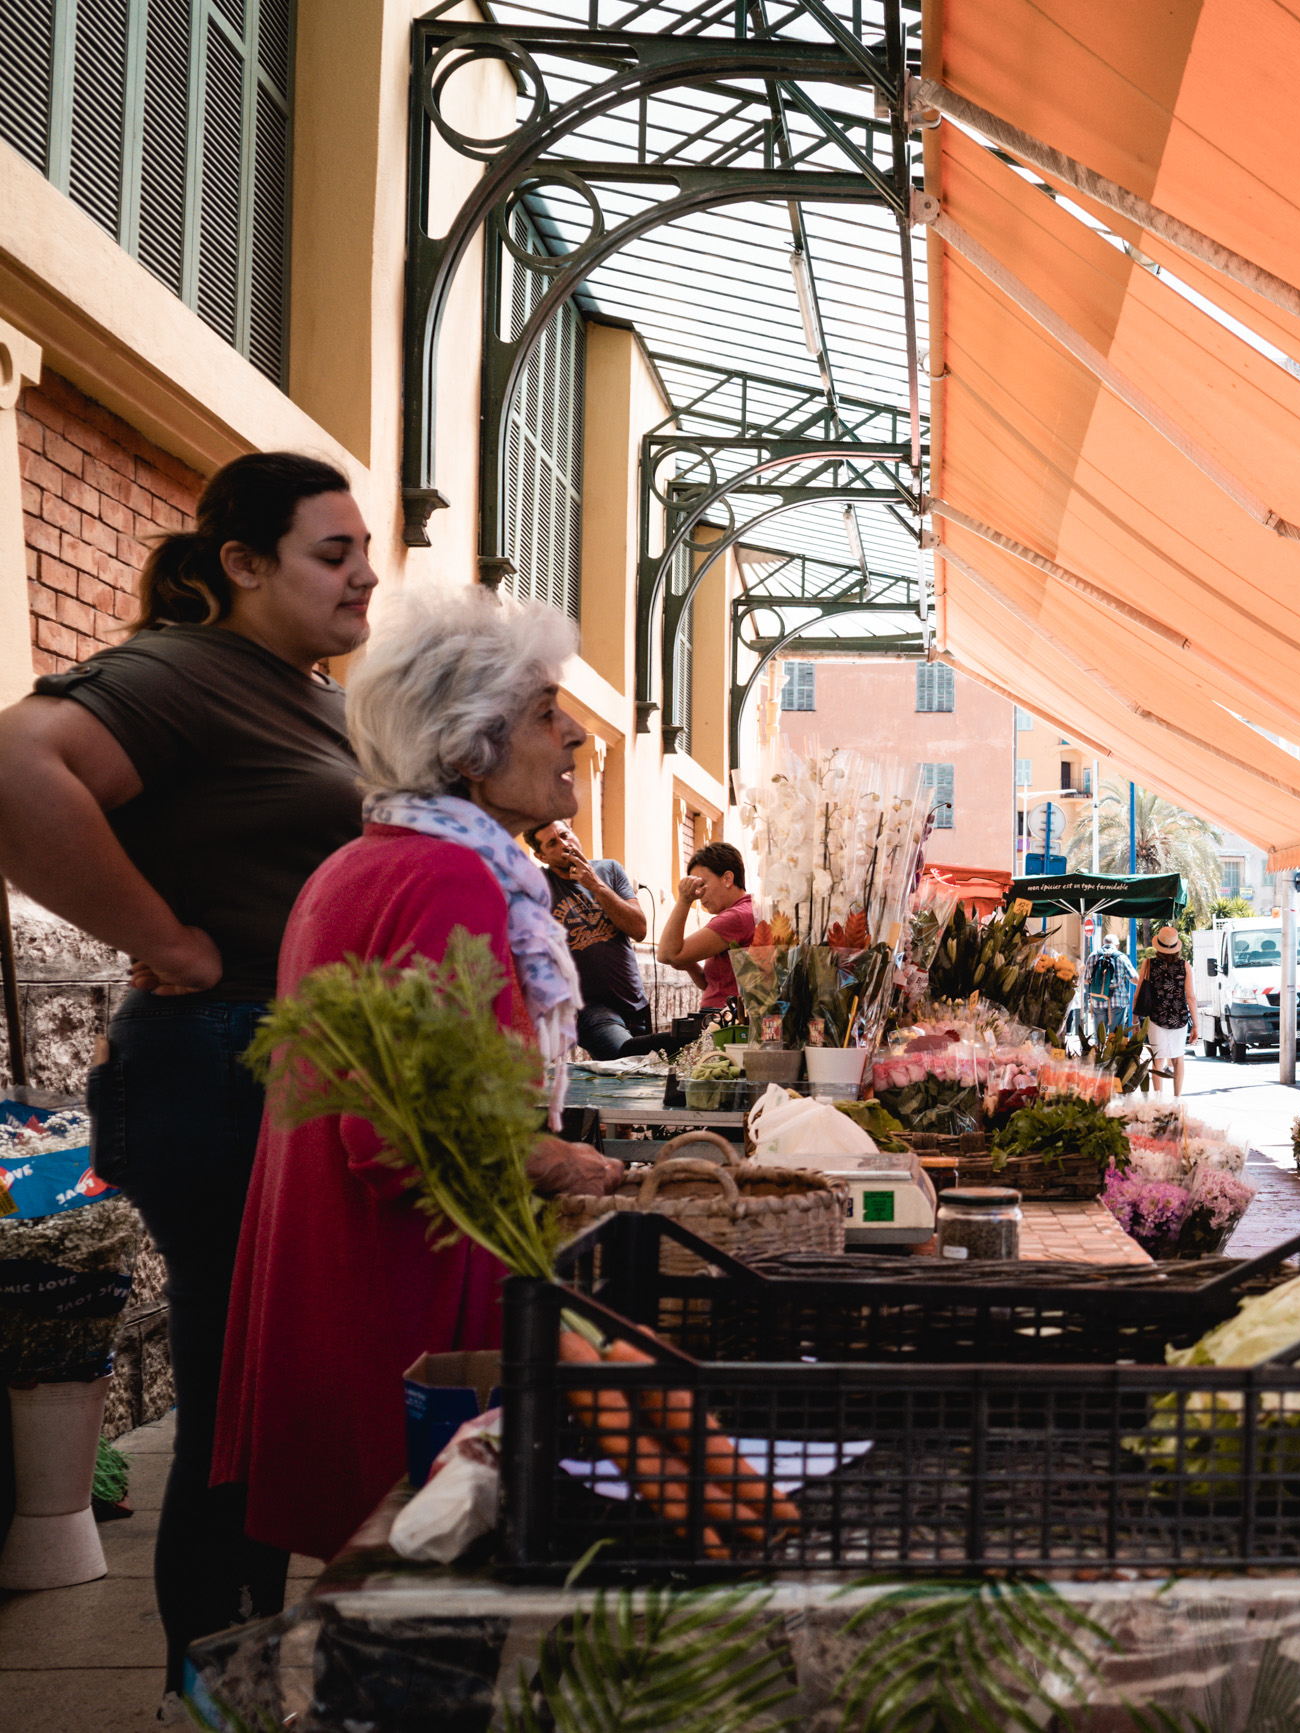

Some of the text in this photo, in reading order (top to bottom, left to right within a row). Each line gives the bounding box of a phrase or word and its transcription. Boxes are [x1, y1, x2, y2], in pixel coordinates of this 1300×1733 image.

[1081, 882, 1096, 891] type
[1096, 882, 1129, 892] formidable
[38, 1275, 77, 1292] LOVE
